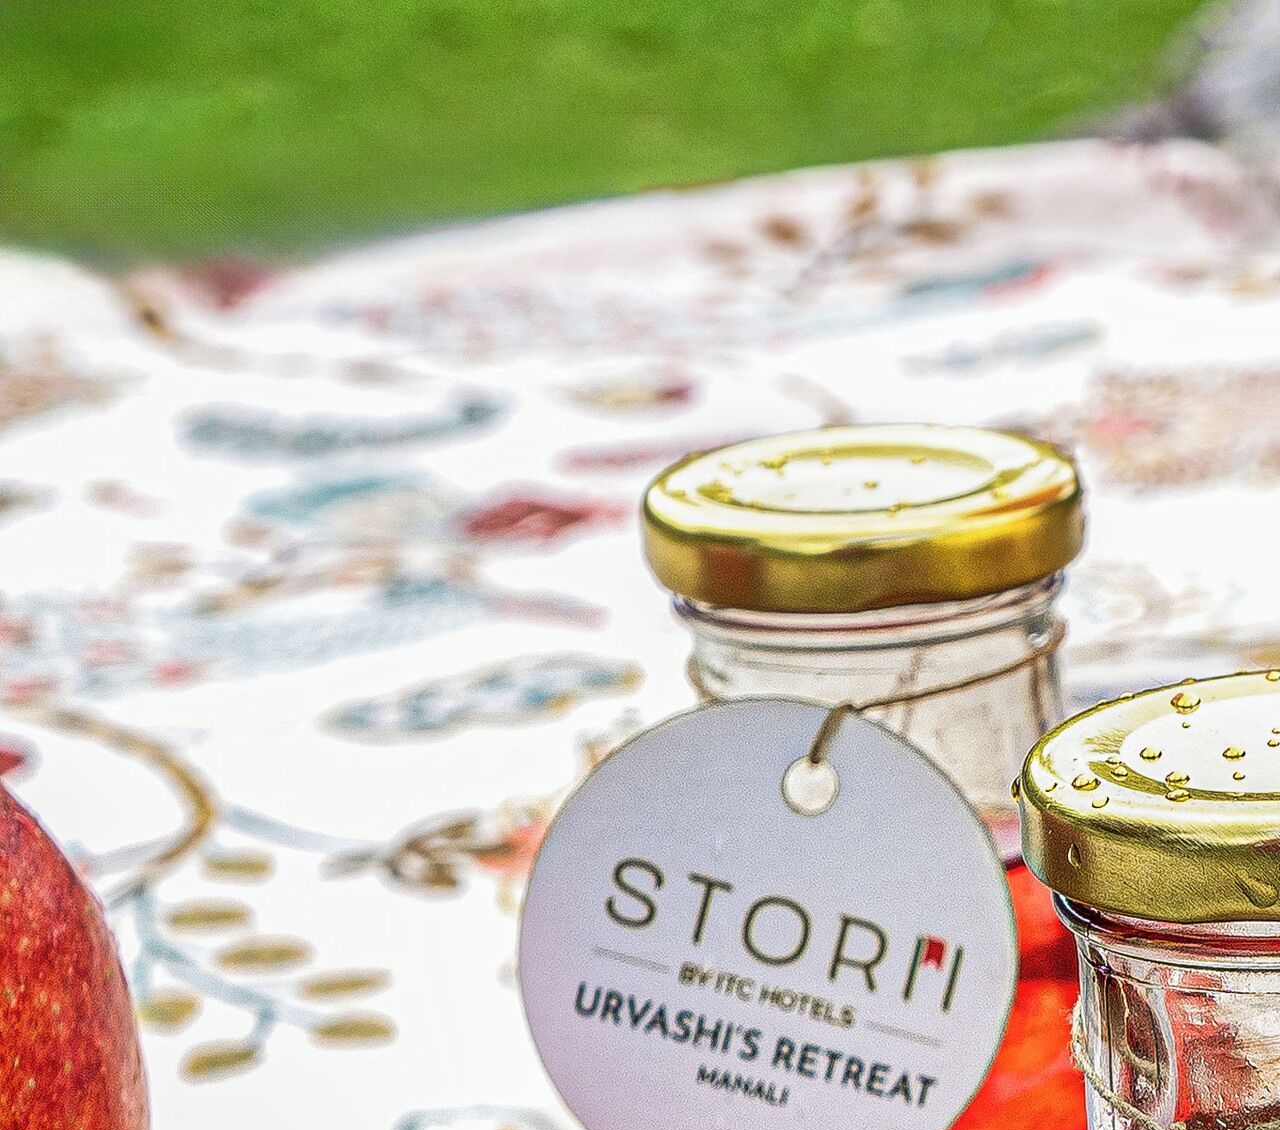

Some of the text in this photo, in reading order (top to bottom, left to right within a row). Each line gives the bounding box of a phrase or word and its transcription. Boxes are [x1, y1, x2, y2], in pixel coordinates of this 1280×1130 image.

[678, 963, 857, 1028] BY ITC HOTELS
[574, 982, 937, 1106] URVASHI'S RETREAT
[697, 1065, 790, 1105] MANALI
